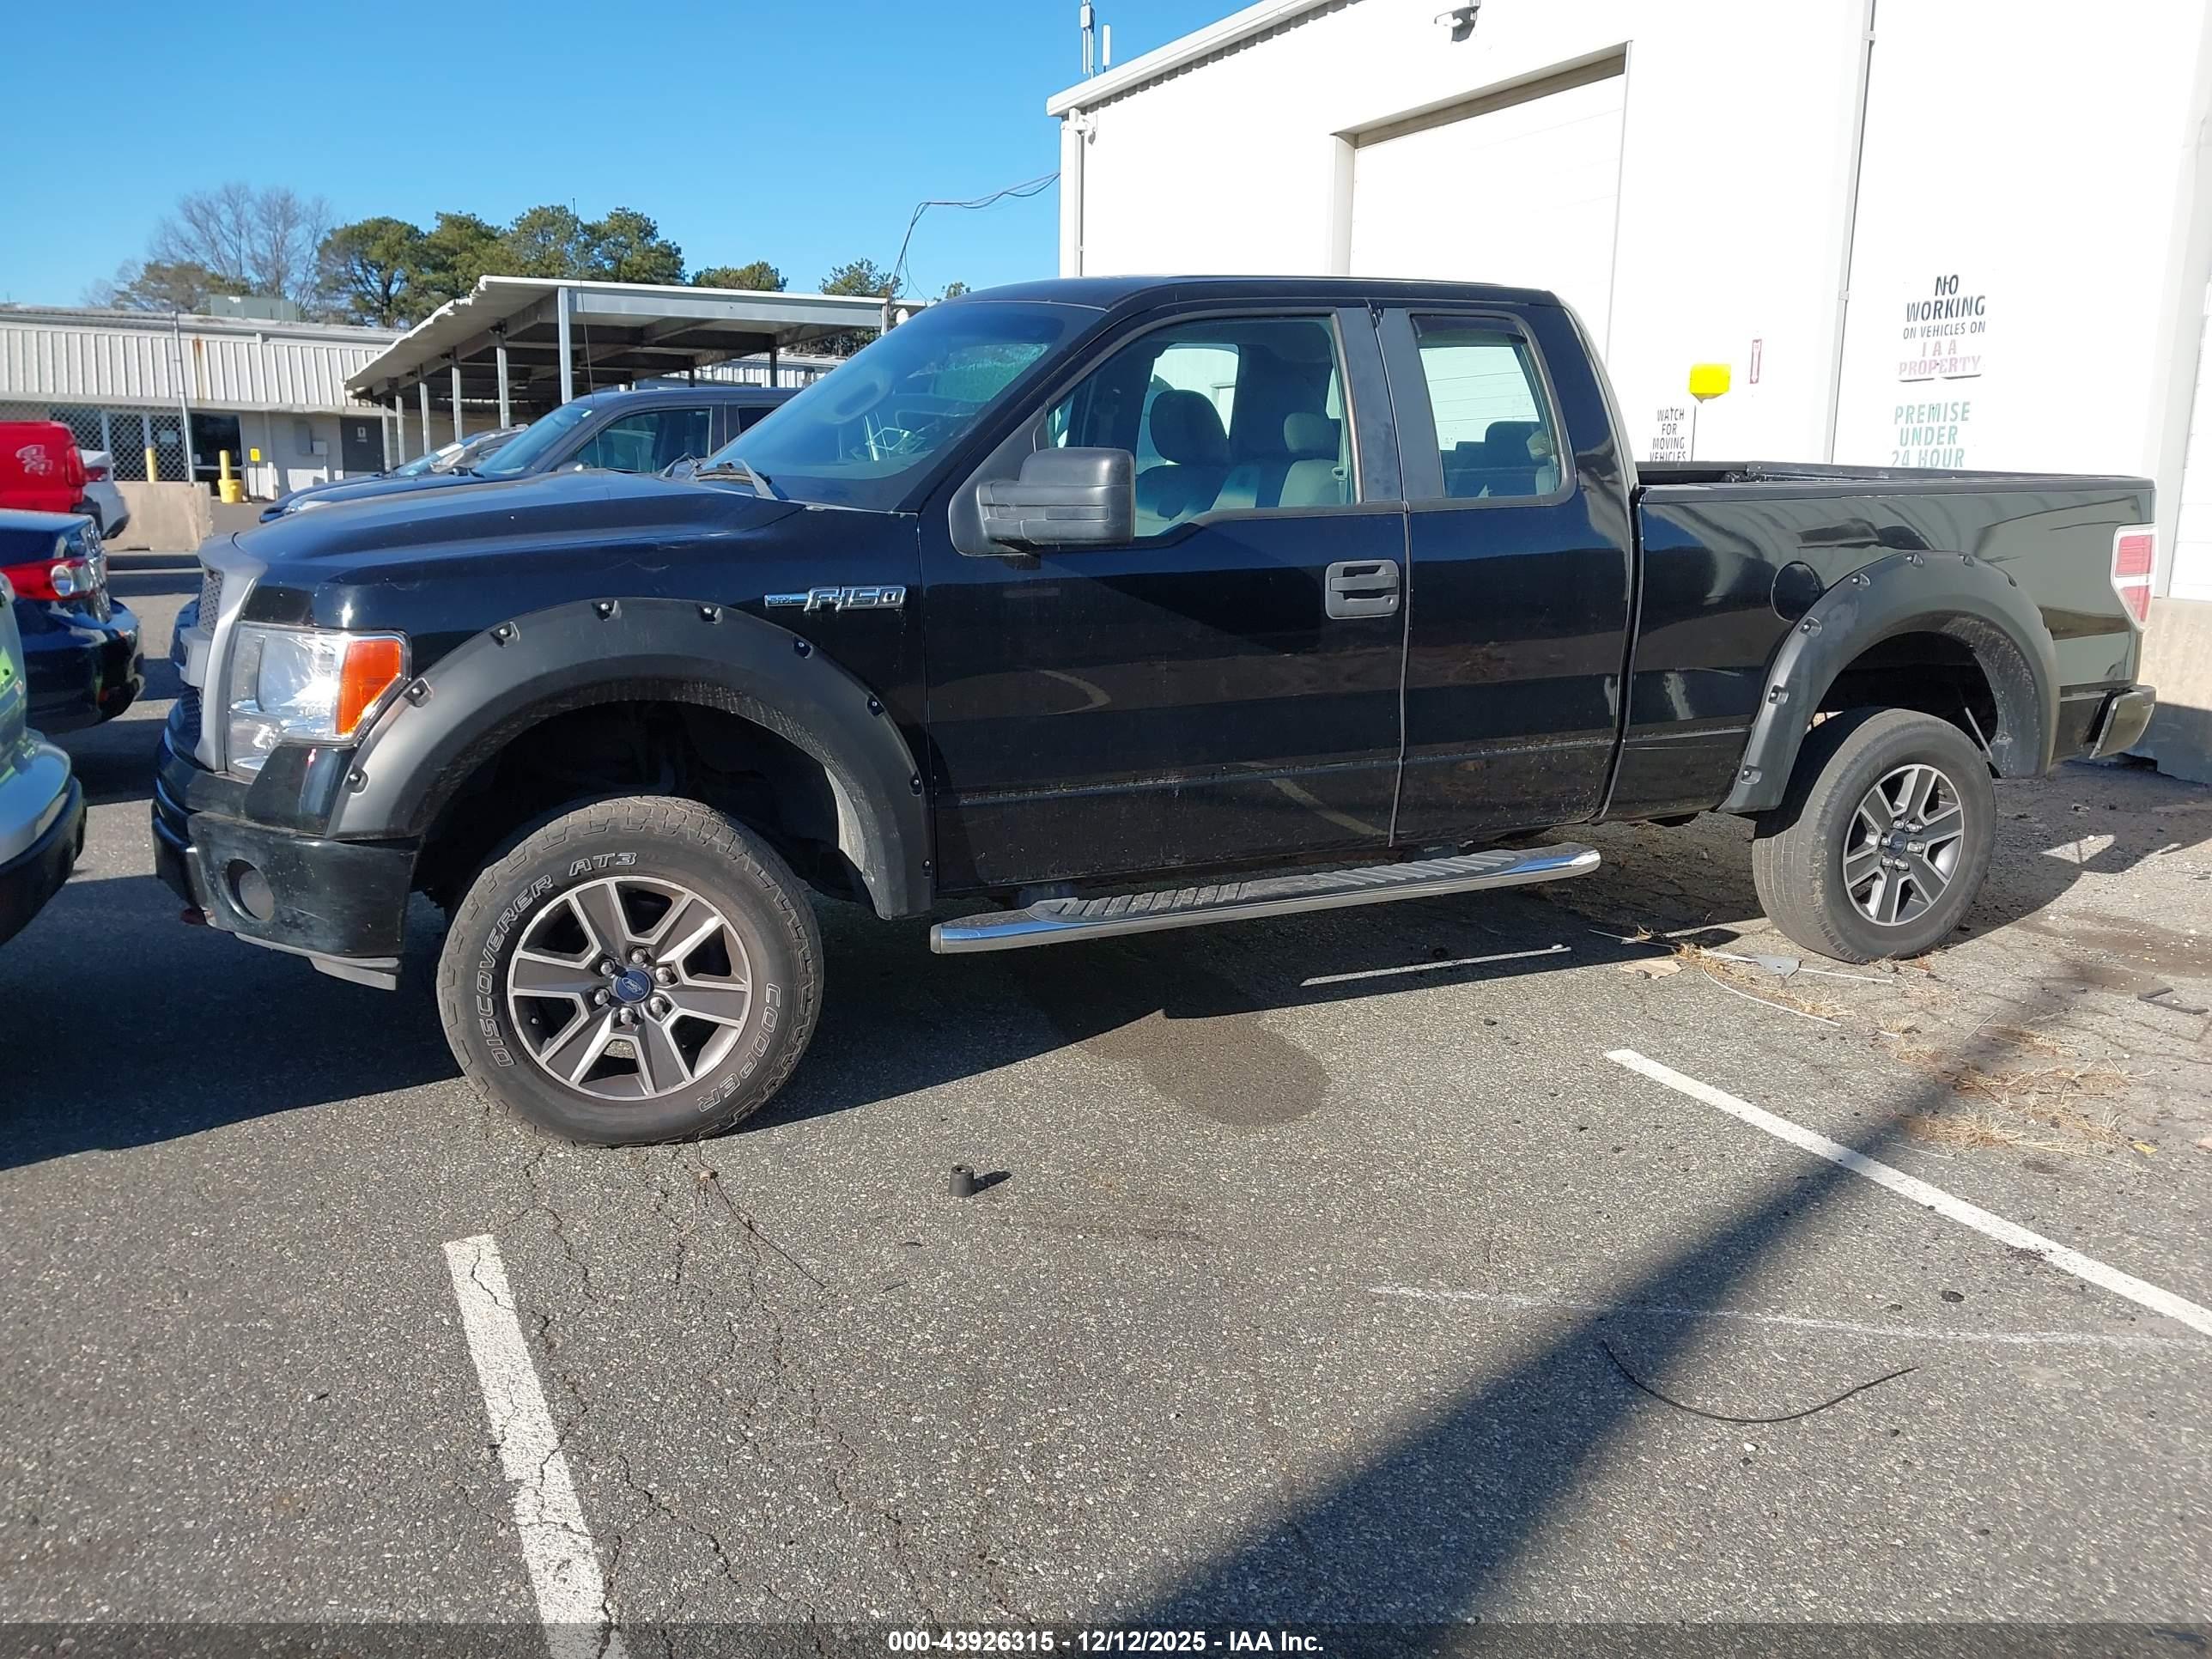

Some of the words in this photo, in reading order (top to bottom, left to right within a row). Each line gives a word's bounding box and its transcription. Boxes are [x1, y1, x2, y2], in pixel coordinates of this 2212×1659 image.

[1935, 274, 1959, 296] NO
[1906, 295, 1986, 322] WORKING
[1903, 327, 1917, 339] ON
[1920, 322, 1966, 337] VEHICLES
[1970, 320, 1986, 334] ON
[1898, 355, 1982, 376] PROPERTY
[1656, 406, 1685, 422] WATCH
[1893, 401, 1971, 425] PREMISE
[1661, 422, 1677, 435] FOR
[1899, 425, 1959, 447] UNDER
[1652, 436, 1685, 450] MOVING
[1891, 449, 1911, 467] 24
[1917, 447, 1966, 469] HOUR
[477, 874, 553, 1068] DISCOVERER
[568, 852, 637, 878] AT3
[696, 982, 781, 1113] COOPER
